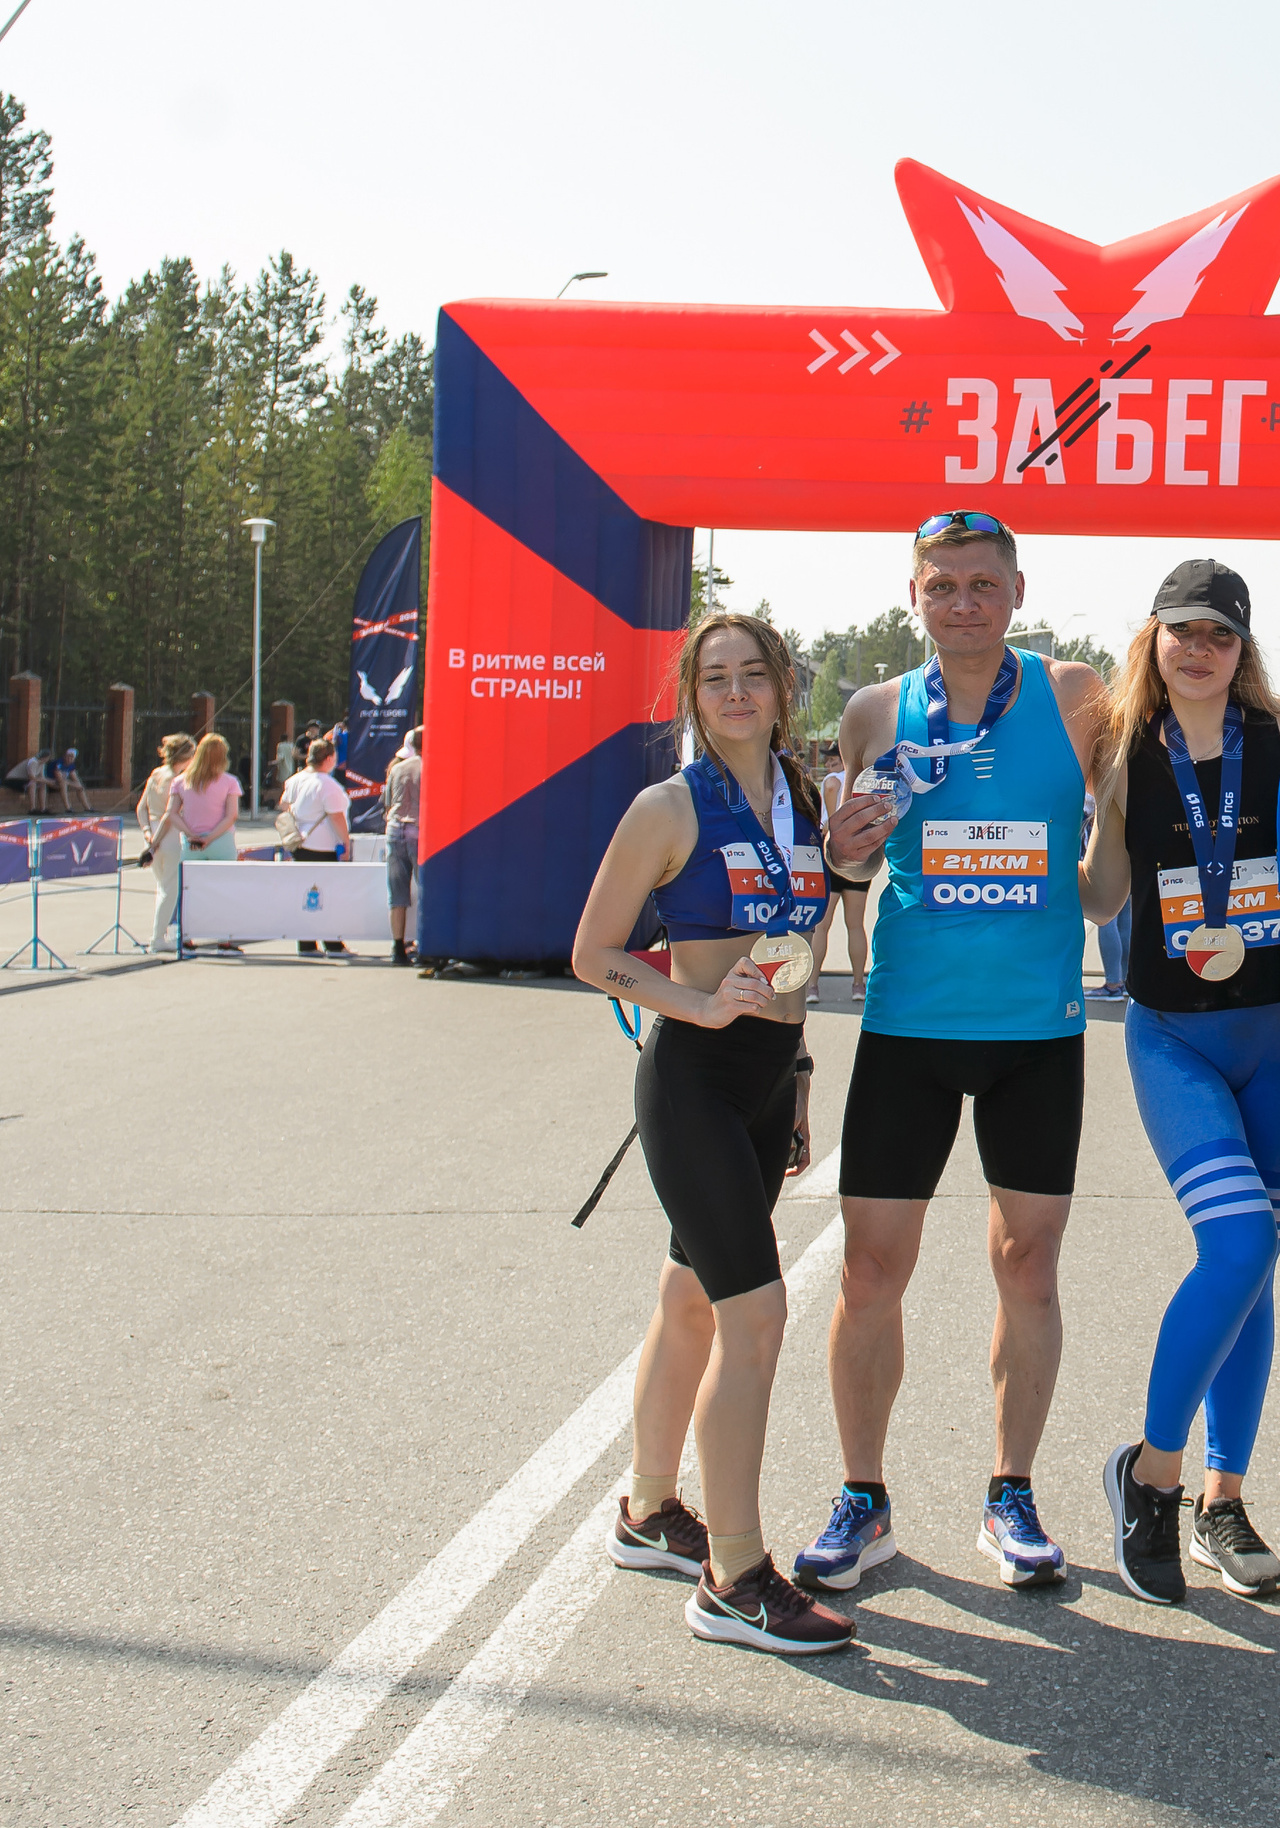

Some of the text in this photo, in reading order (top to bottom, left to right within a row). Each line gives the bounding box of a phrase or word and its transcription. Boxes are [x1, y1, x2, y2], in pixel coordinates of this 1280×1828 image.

[448, 648, 605, 672] В ритме всей
[470, 677, 582, 700] СТРАНЫ!
[1223, 792, 1234, 813] ПСБ
[1191, 805, 1205, 828] ПСБ
[933, 883, 1038, 904] 00041
